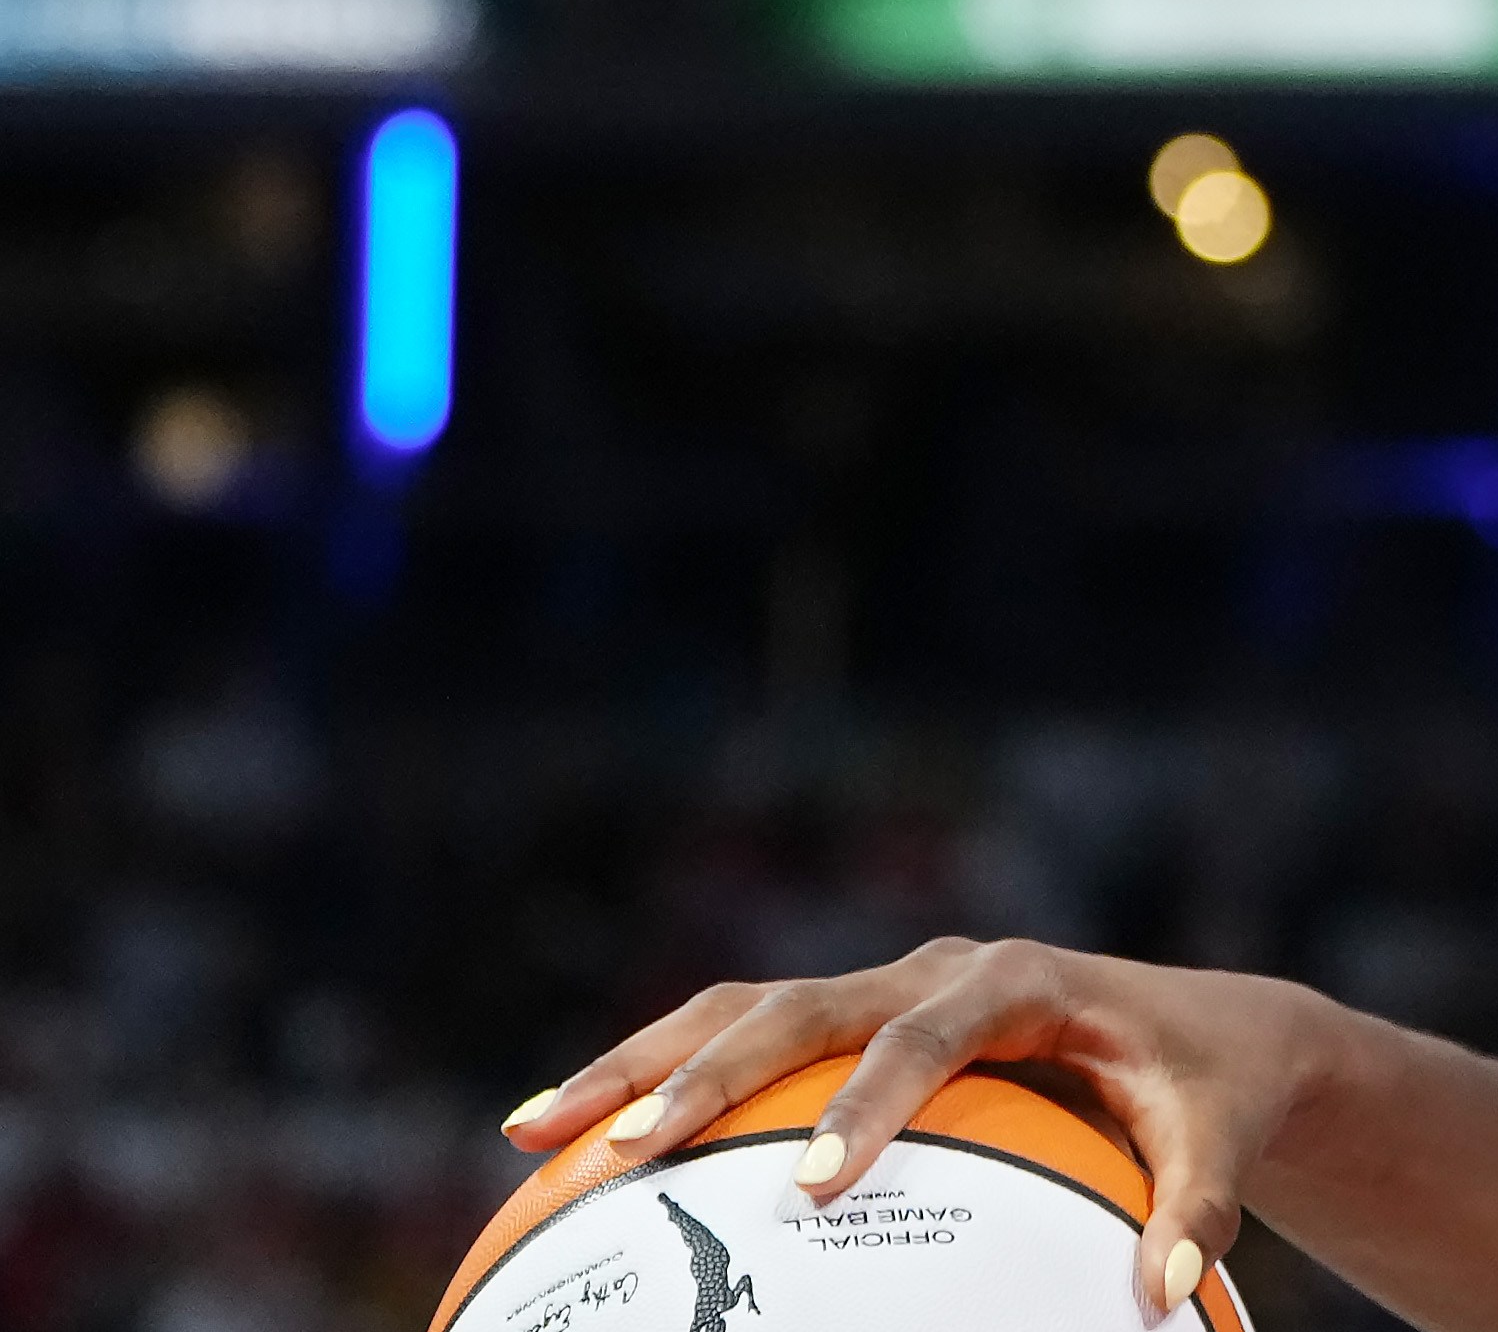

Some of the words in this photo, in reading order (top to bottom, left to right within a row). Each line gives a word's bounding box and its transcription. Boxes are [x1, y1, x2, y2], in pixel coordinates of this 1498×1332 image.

[782, 1210, 868, 1232] BALL
[876, 1207, 972, 1222] GAME
[808, 1230, 955, 1251] OFFICIAL
